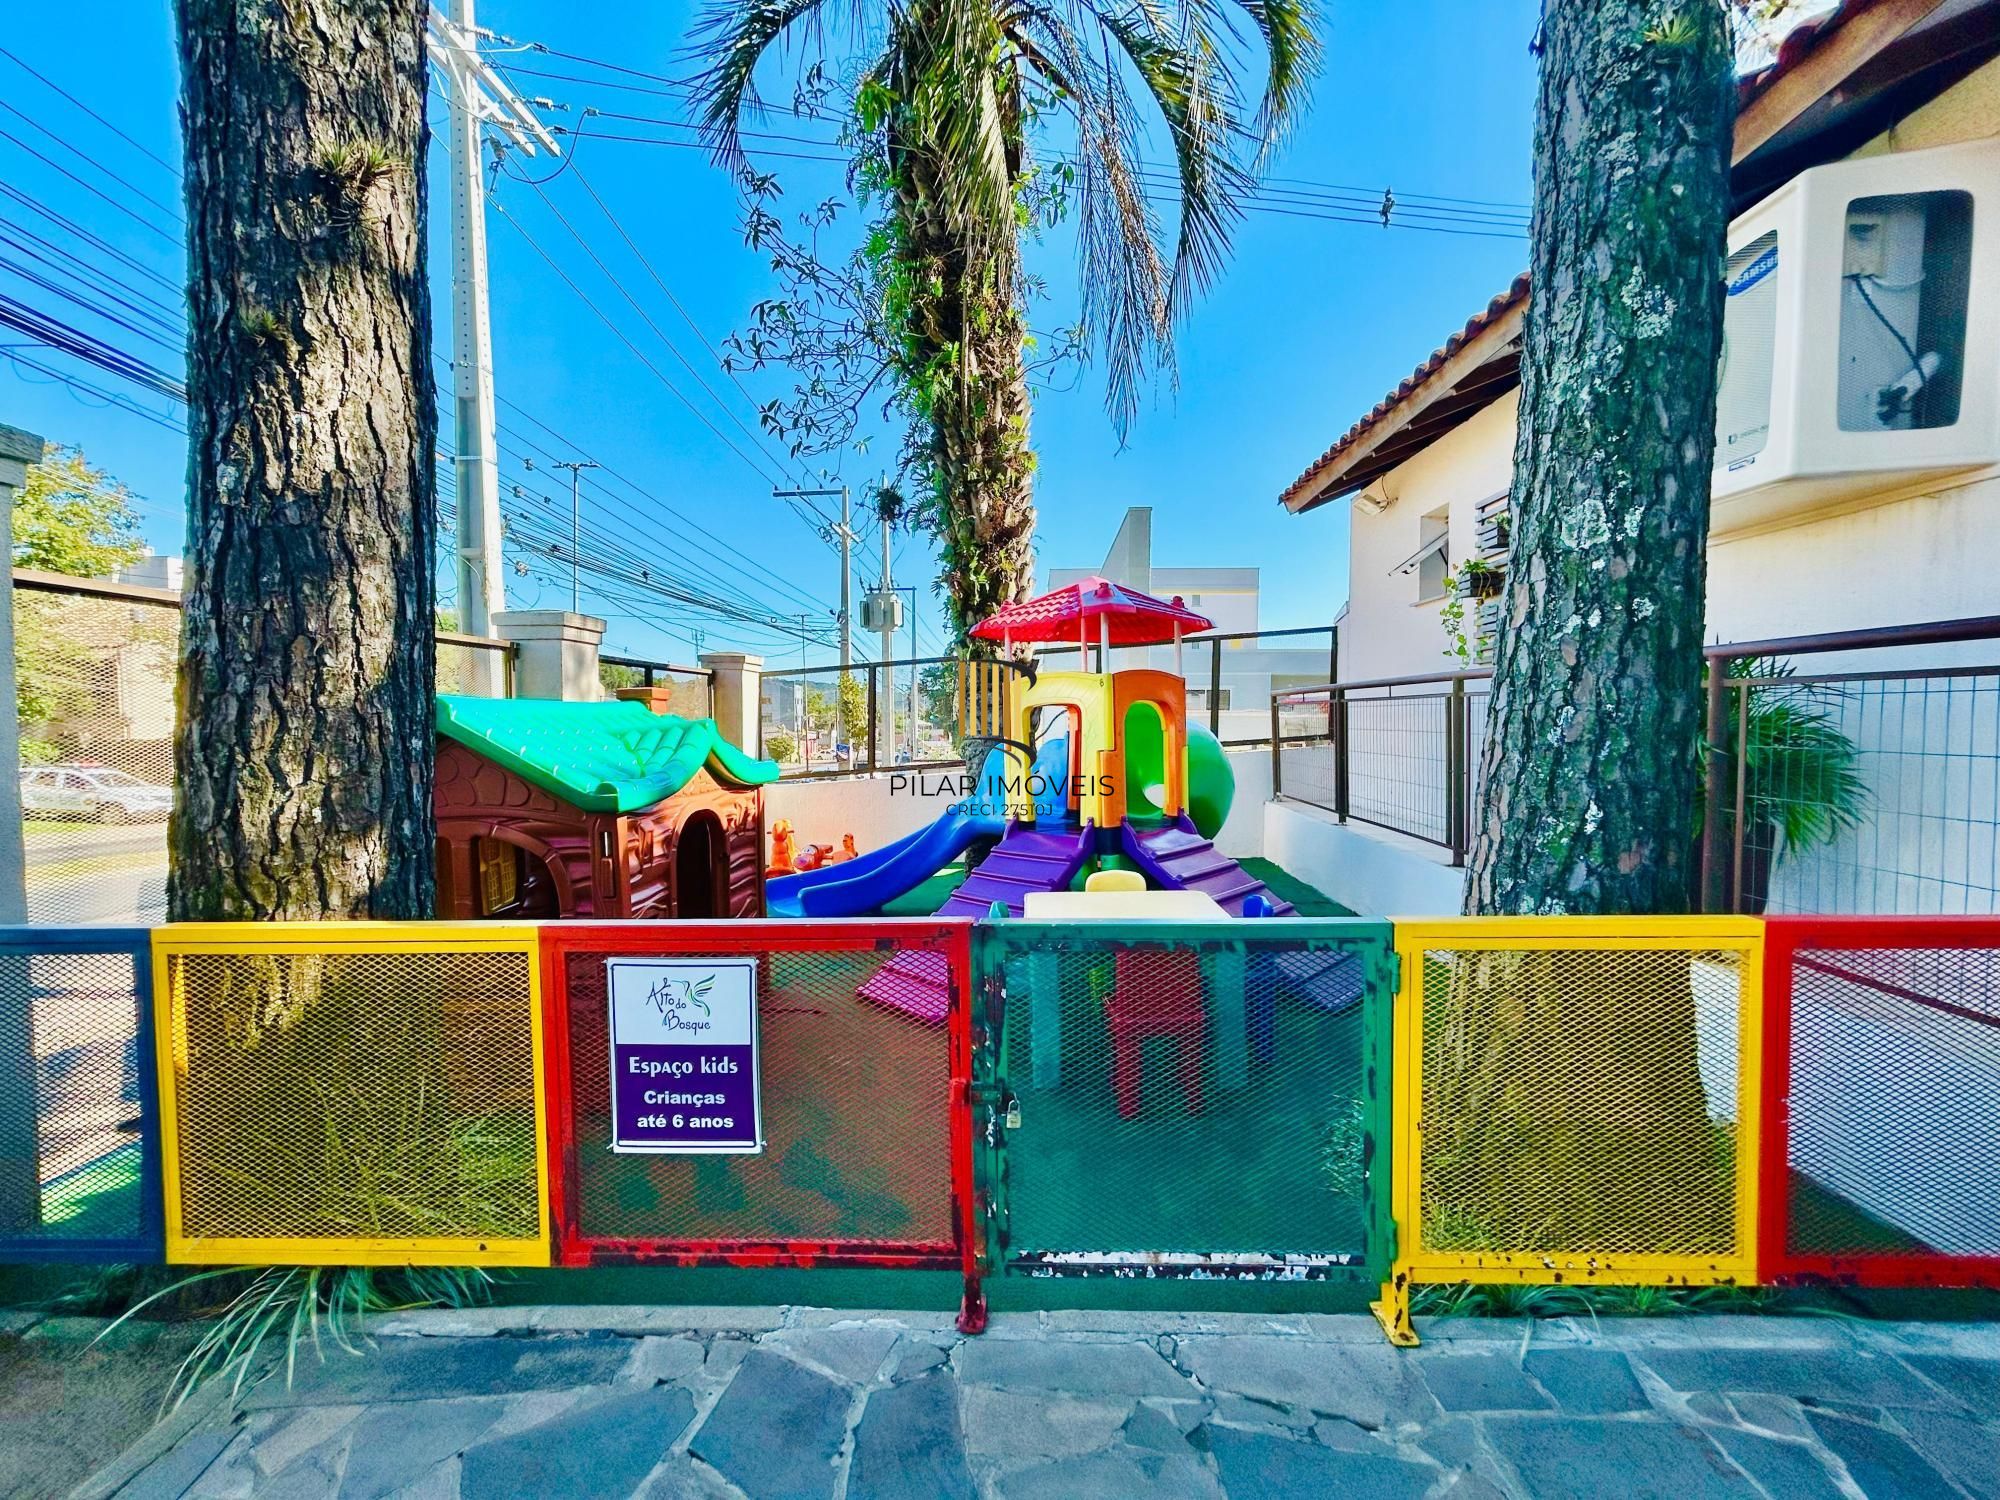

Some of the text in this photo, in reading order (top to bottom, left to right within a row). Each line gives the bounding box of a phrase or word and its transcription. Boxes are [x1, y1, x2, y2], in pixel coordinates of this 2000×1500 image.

[646, 977, 687, 1013] Alto do
[662, 1009, 710, 1036] Bosque
[700, 1056, 738, 1074] kids
[643, 1090, 726, 1107] Crianças
[637, 1114, 734, 1128] até 6 anos
